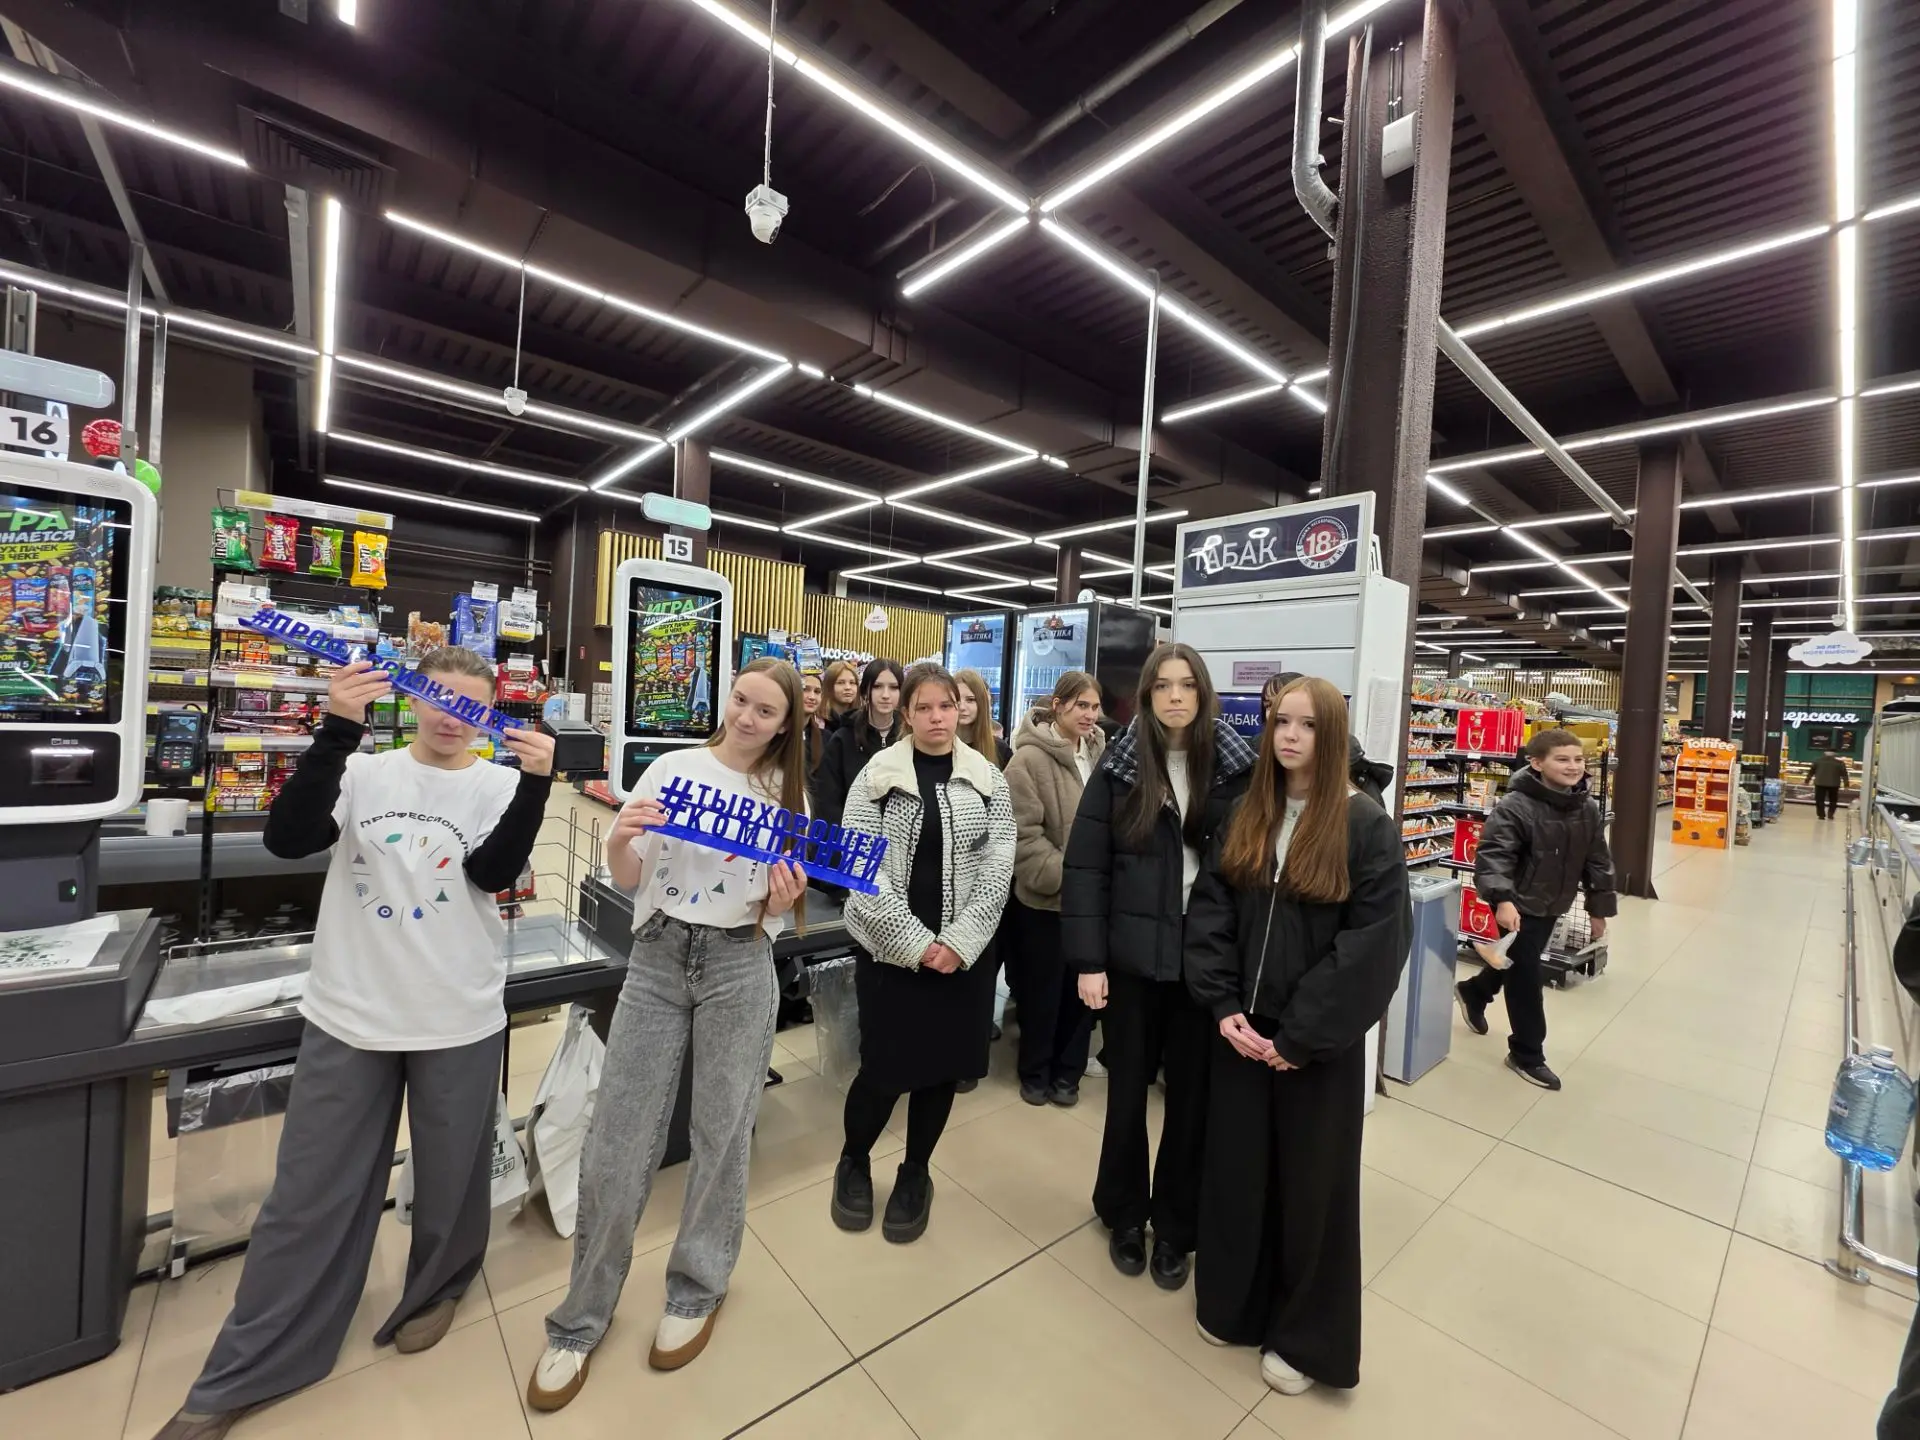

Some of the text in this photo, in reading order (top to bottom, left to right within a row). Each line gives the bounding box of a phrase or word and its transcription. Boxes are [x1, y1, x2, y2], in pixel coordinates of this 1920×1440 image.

[10, 417, 58, 445] 16
[0, 530, 76, 543] НАЕТСЯ
[1306, 531, 1339, 556] 18+
[20, 544, 58, 552] ПАЧЕК
[668, 539, 688, 556] 15
[1191, 536, 1278, 571] ТАБАК
[646, 599, 696, 617] ИГРА
[23, 660, 29, 668] 5
[251, 608, 525, 733] #ПРОФССИОНАЛИТЕТ
[1221, 713, 1259, 726] ТАБАК
[1685, 738, 1736, 752] Toffifee
